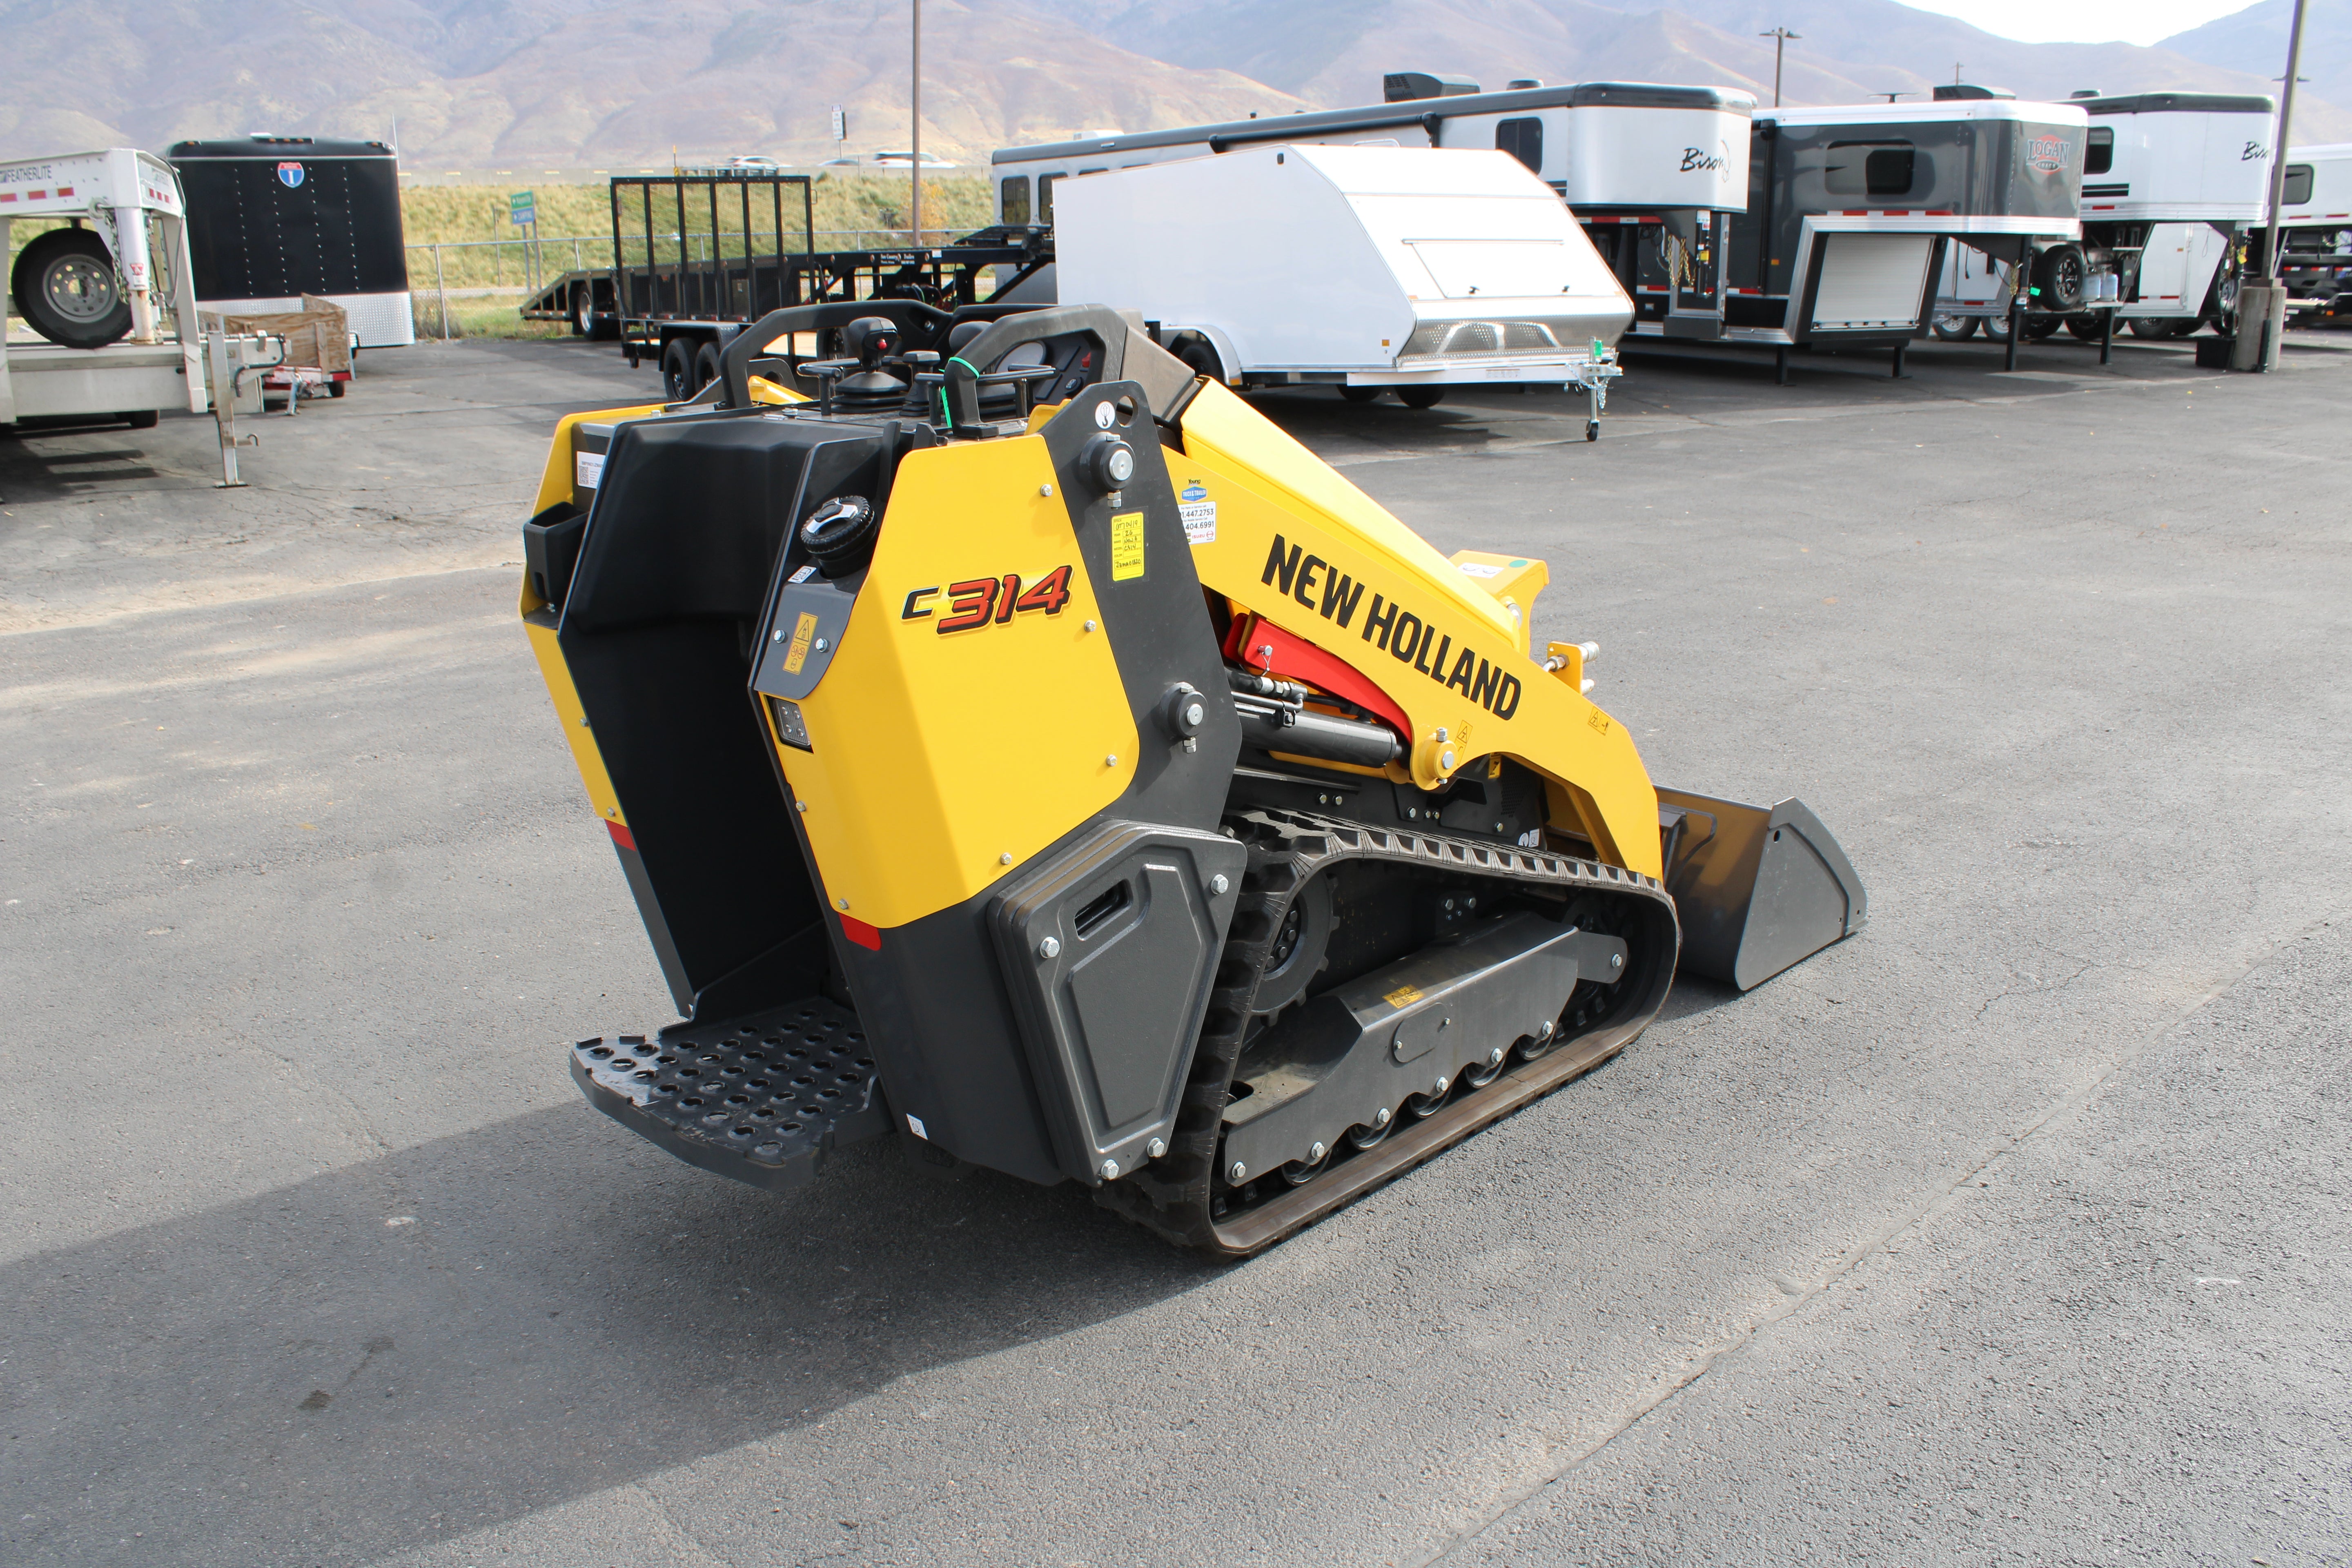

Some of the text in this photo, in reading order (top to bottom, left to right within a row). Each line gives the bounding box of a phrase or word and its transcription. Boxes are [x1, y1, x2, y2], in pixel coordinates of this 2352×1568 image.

[1680, 147, 1724, 172] Bison
[2027, 139, 2070, 164] LOGAN
[7, 165, 51, 183] FEATHERLITE
[901, 565, 1073, 635] C314
[1261, 533, 1521, 721] NEW HOLLAND
